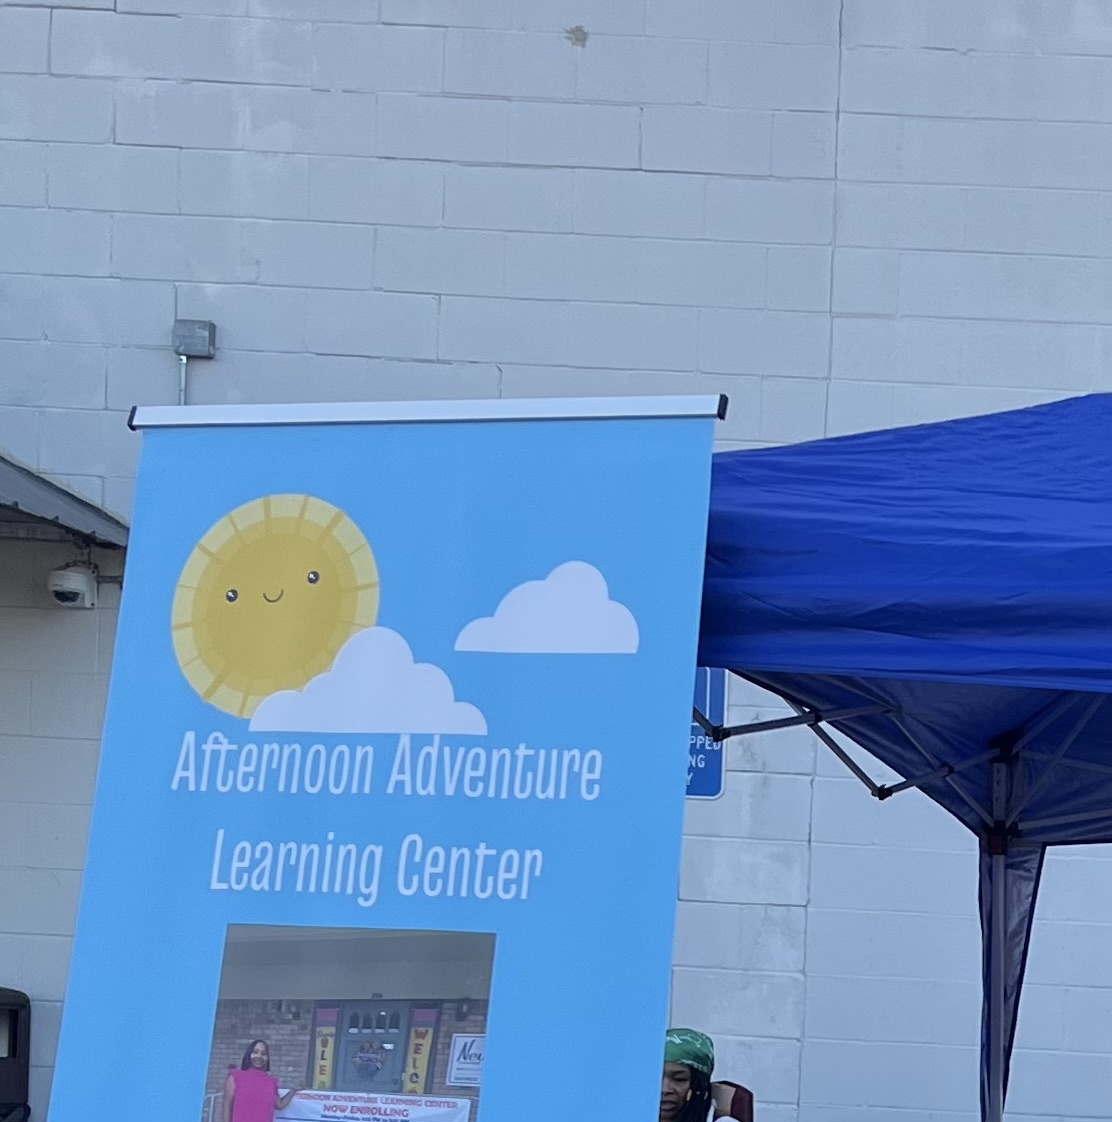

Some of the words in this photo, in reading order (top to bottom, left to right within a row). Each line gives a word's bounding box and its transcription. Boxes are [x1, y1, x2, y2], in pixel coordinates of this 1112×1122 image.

[171, 730, 374, 795] Afternoon
[387, 733, 602, 800] Adventure
[209, 828, 383, 907] Learning
[398, 834, 543, 900] Center
[323, 1104, 348, 1114] NOW
[350, 1105, 409, 1118] ENROLLING
